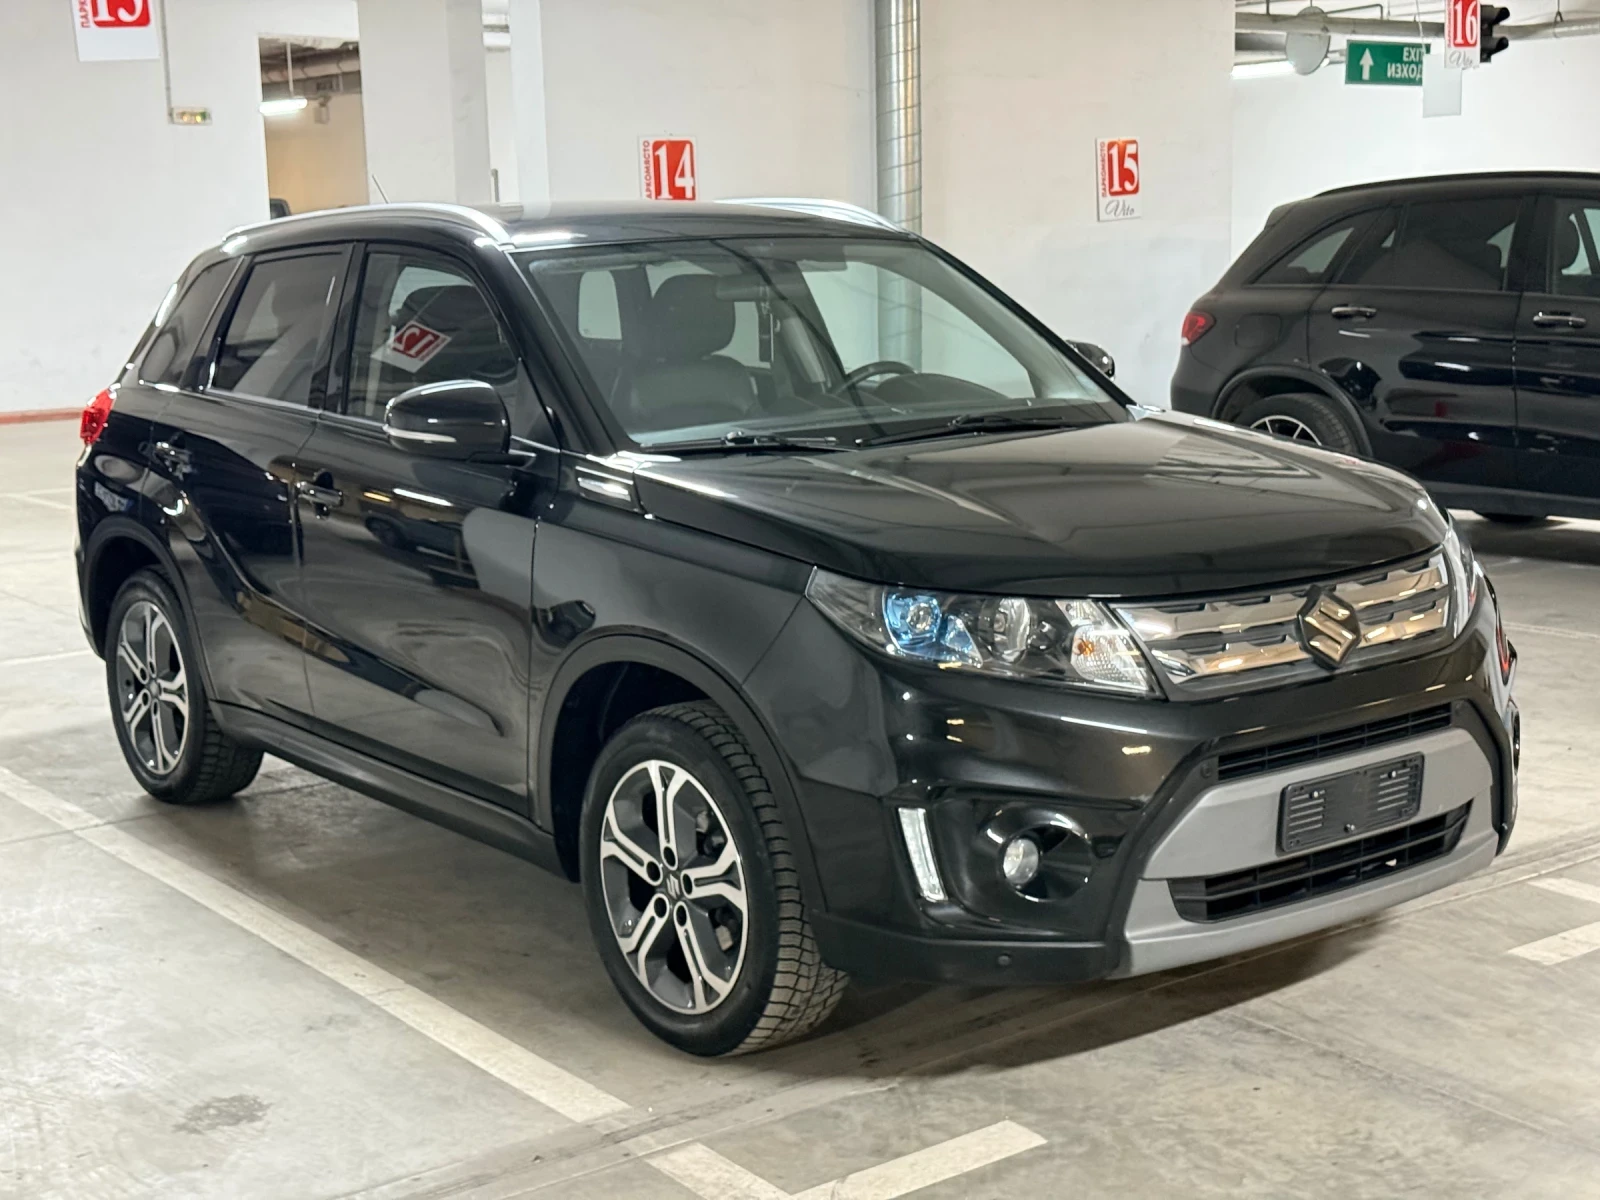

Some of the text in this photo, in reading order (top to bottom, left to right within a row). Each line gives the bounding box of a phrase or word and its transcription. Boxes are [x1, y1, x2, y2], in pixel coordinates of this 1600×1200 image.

[1454, 0, 1477, 44] 16
[643, 140, 653, 199] АРКОМЯСТО
[655, 143, 694, 199] 14
[1108, 144, 1138, 192] 15
